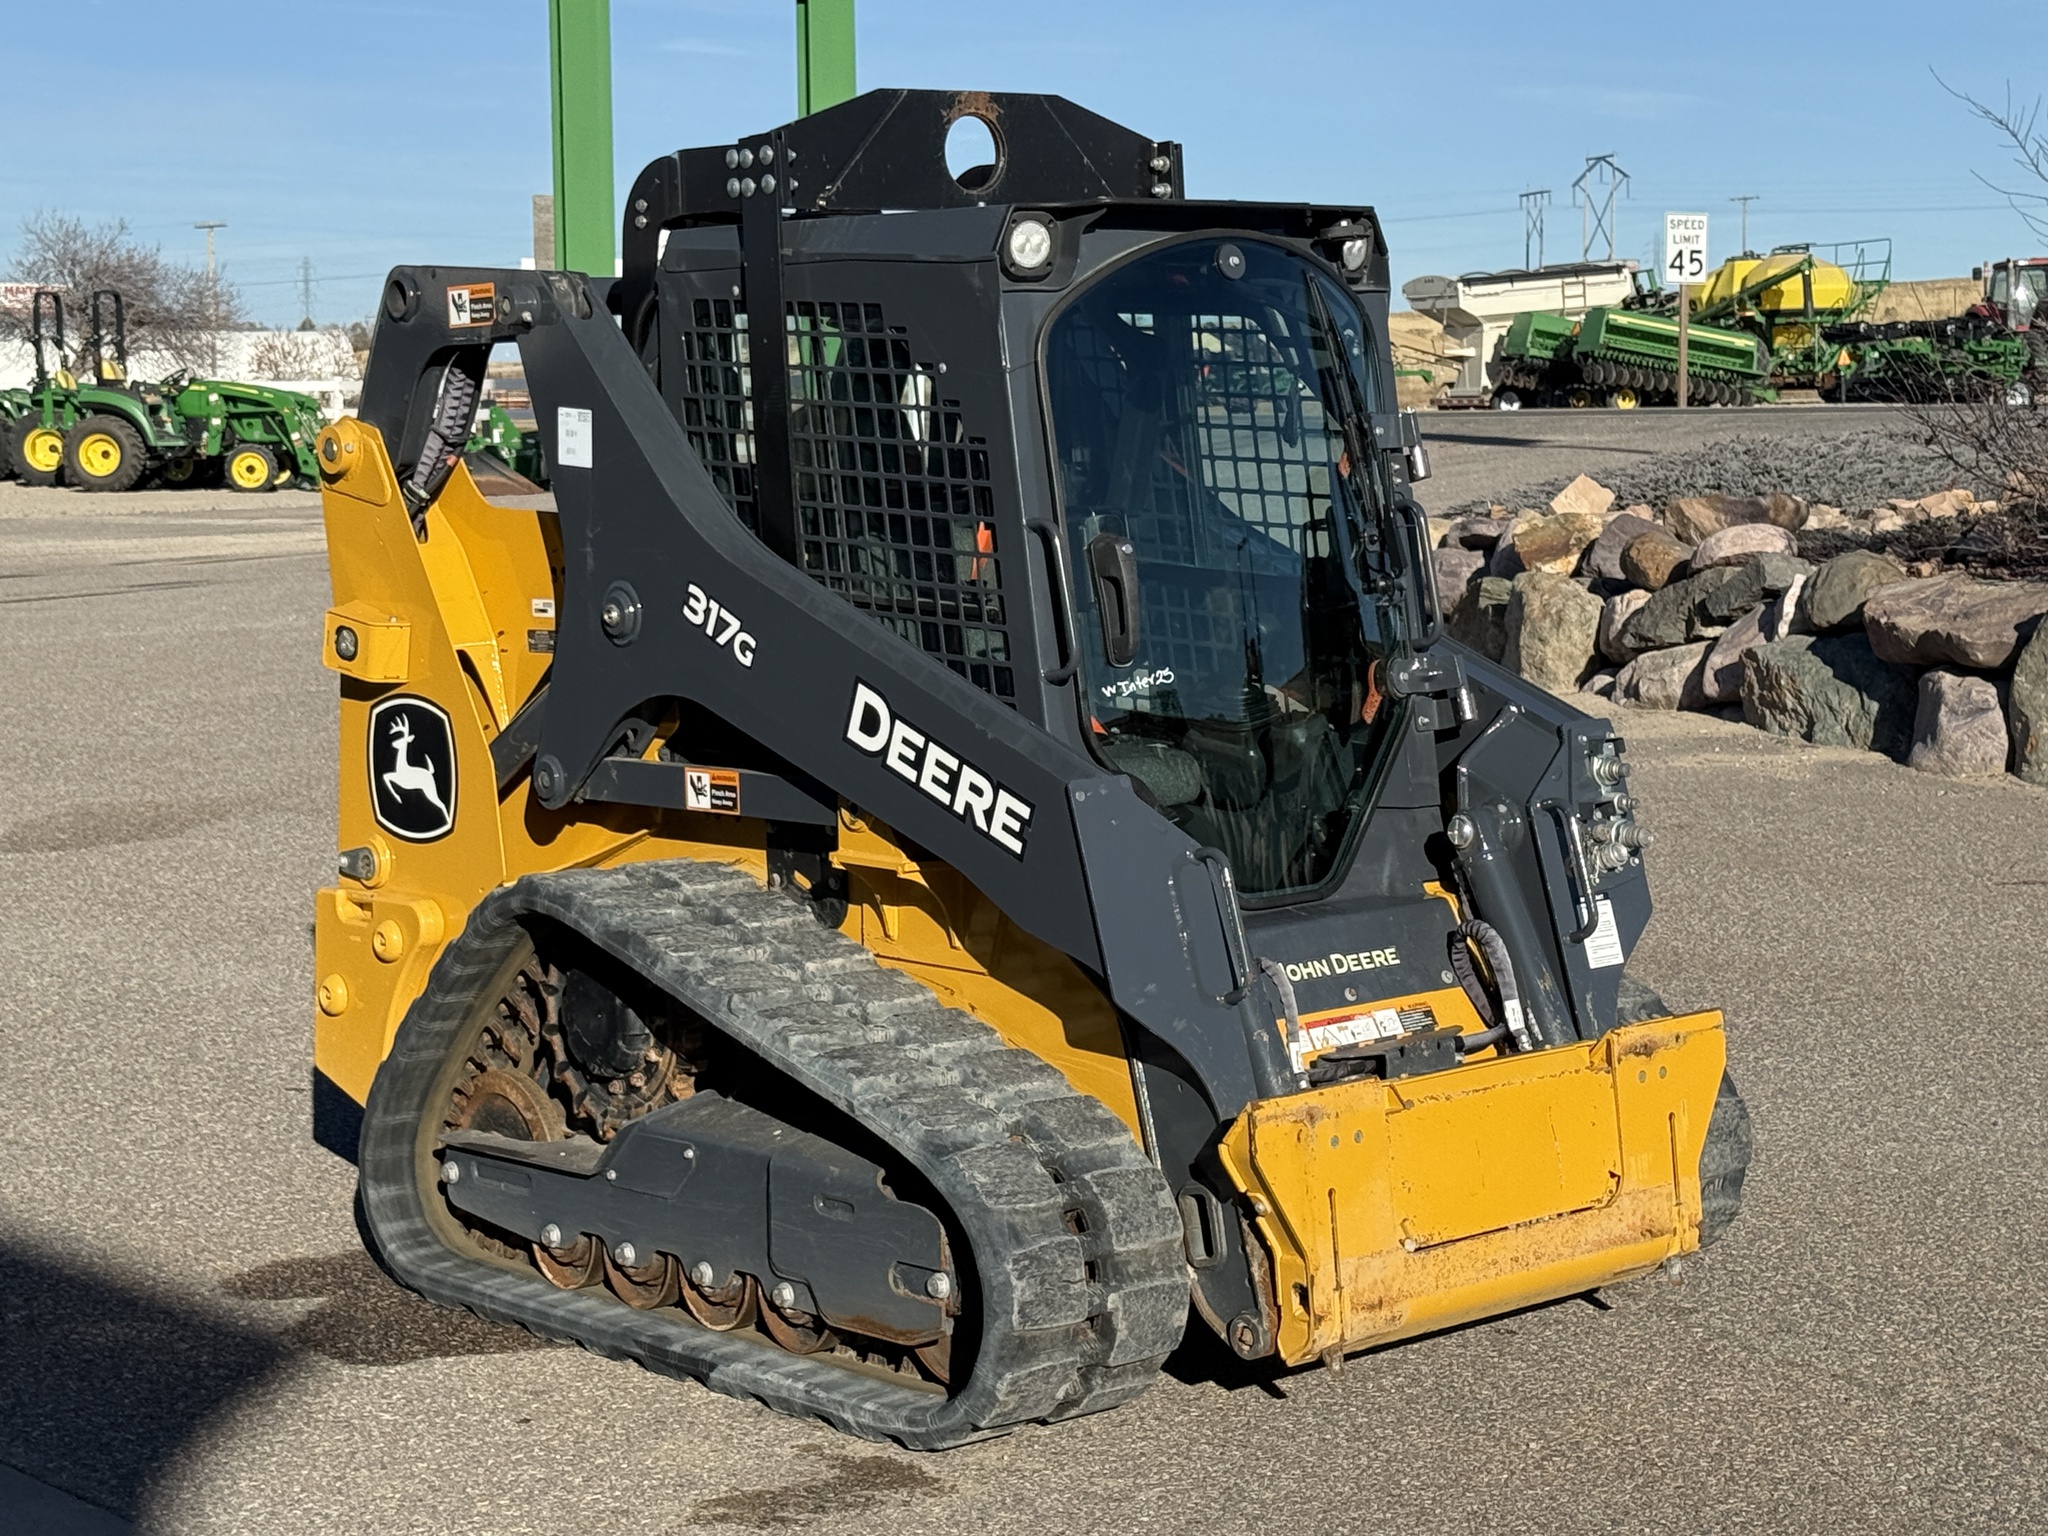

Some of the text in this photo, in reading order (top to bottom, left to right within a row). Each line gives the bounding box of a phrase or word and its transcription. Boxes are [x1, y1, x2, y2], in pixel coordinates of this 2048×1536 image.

[1670, 218, 1704, 230] SPEED
[1673, 234, 1700, 245] LIMIT
[1669, 249, 1703, 276] 45
[683, 583, 757, 667] 317G
[847, 683, 1031, 854] DEERE
[1330, 947, 1400, 974] DEERE
